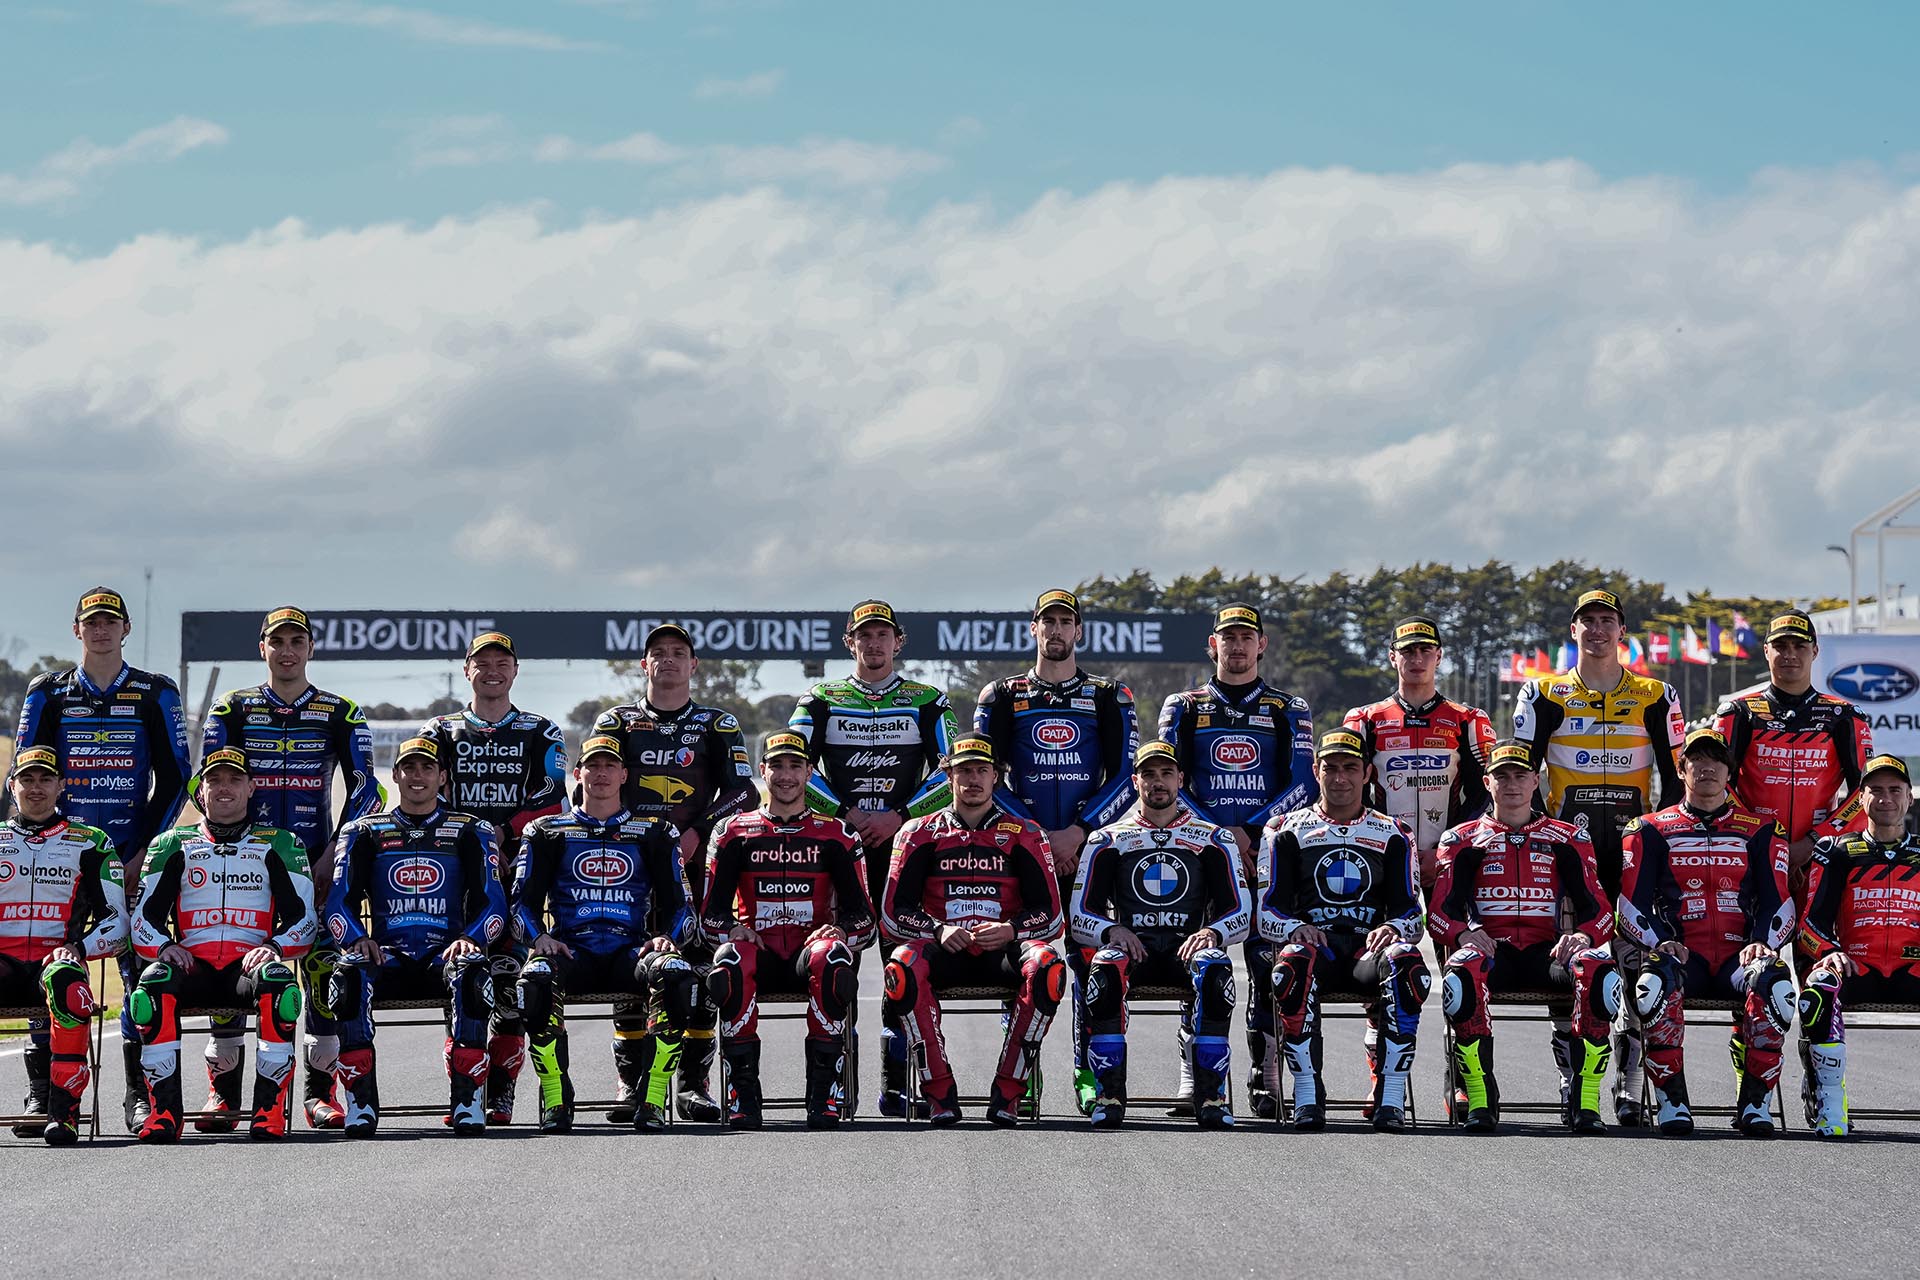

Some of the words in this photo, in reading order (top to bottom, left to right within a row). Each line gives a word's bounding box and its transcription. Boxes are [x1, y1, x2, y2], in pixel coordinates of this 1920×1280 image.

[84, 594, 118, 606] PIRELLI
[855, 605, 890, 618] PIRELLI
[1222, 609, 1256, 620] PIRELLI
[1772, 617, 1807, 629] PIRELLI
[937, 620, 1163, 652] MELBURNE
[1399, 624, 1433, 636] PIRELLI
[838, 720, 910, 732] Kawasaki
[109, 733, 136, 741] racing
[1042, 729, 1070, 739] PATA
[1325, 735, 1359, 746] PIRELLI
[297, 741, 325, 750] racing
[770, 736, 803, 748] PIRELLI
[956, 742, 990, 753] PIRELLI
[19, 751, 54, 763] PIRELLI
[208, 751, 243, 763] PIRELLI
[456, 741, 524, 760] Optical
[1219, 747, 1252, 759] PATA
[1494, 749, 1528, 760] PIRELLI
[1756, 743, 1828, 759] barni
[69, 759, 133, 767] TULIPANO
[640, 750, 674, 765] elf
[846, 751, 901, 769] Ninja
[1033, 752, 1082, 766] YAMAHA
[1590, 752, 1633, 765] edisol
[457, 757, 523, 777] Express
[91, 774, 135, 790] polytec
[1209, 774, 1266, 791] YAMAHA
[1406, 775, 1450, 788] MOTOCORSA
[1764, 775, 1819, 786] SPARK
[460, 782, 518, 802] MGM
[806, 791, 828, 809] asaki
[918, 788, 950, 812] Kawasa
[750, 843, 821, 864] aruba.it
[585, 861, 621, 874] PATA
[940, 852, 1006, 872] aruba.it
[1671, 856, 1745, 866] HONDA
[19, 865, 72, 878] bimota
[211, 872, 263, 884] bimota
[400, 869, 433, 882] PATA
[34, 877, 72, 886] Kawasaki
[758, 881, 811, 894] Lenovo
[571, 888, 635, 903] YAMAHA
[948, 884, 997, 895] Lenovo
[1476, 887, 1555, 899] HONDA
[3, 905, 62, 919] MOTUL
[387, 897, 447, 915] YAMAHA
[592, 907, 629, 916] MAXUS
[961, 901, 984, 912] riello
[191, 910, 258, 927] MOTUL
[795, 910, 808, 918] ups
[1131, 911, 1190, 927] RoKiT
[1307, 906, 1377, 925] RoKiT
[1853, 916, 1910, 928] SPARK
